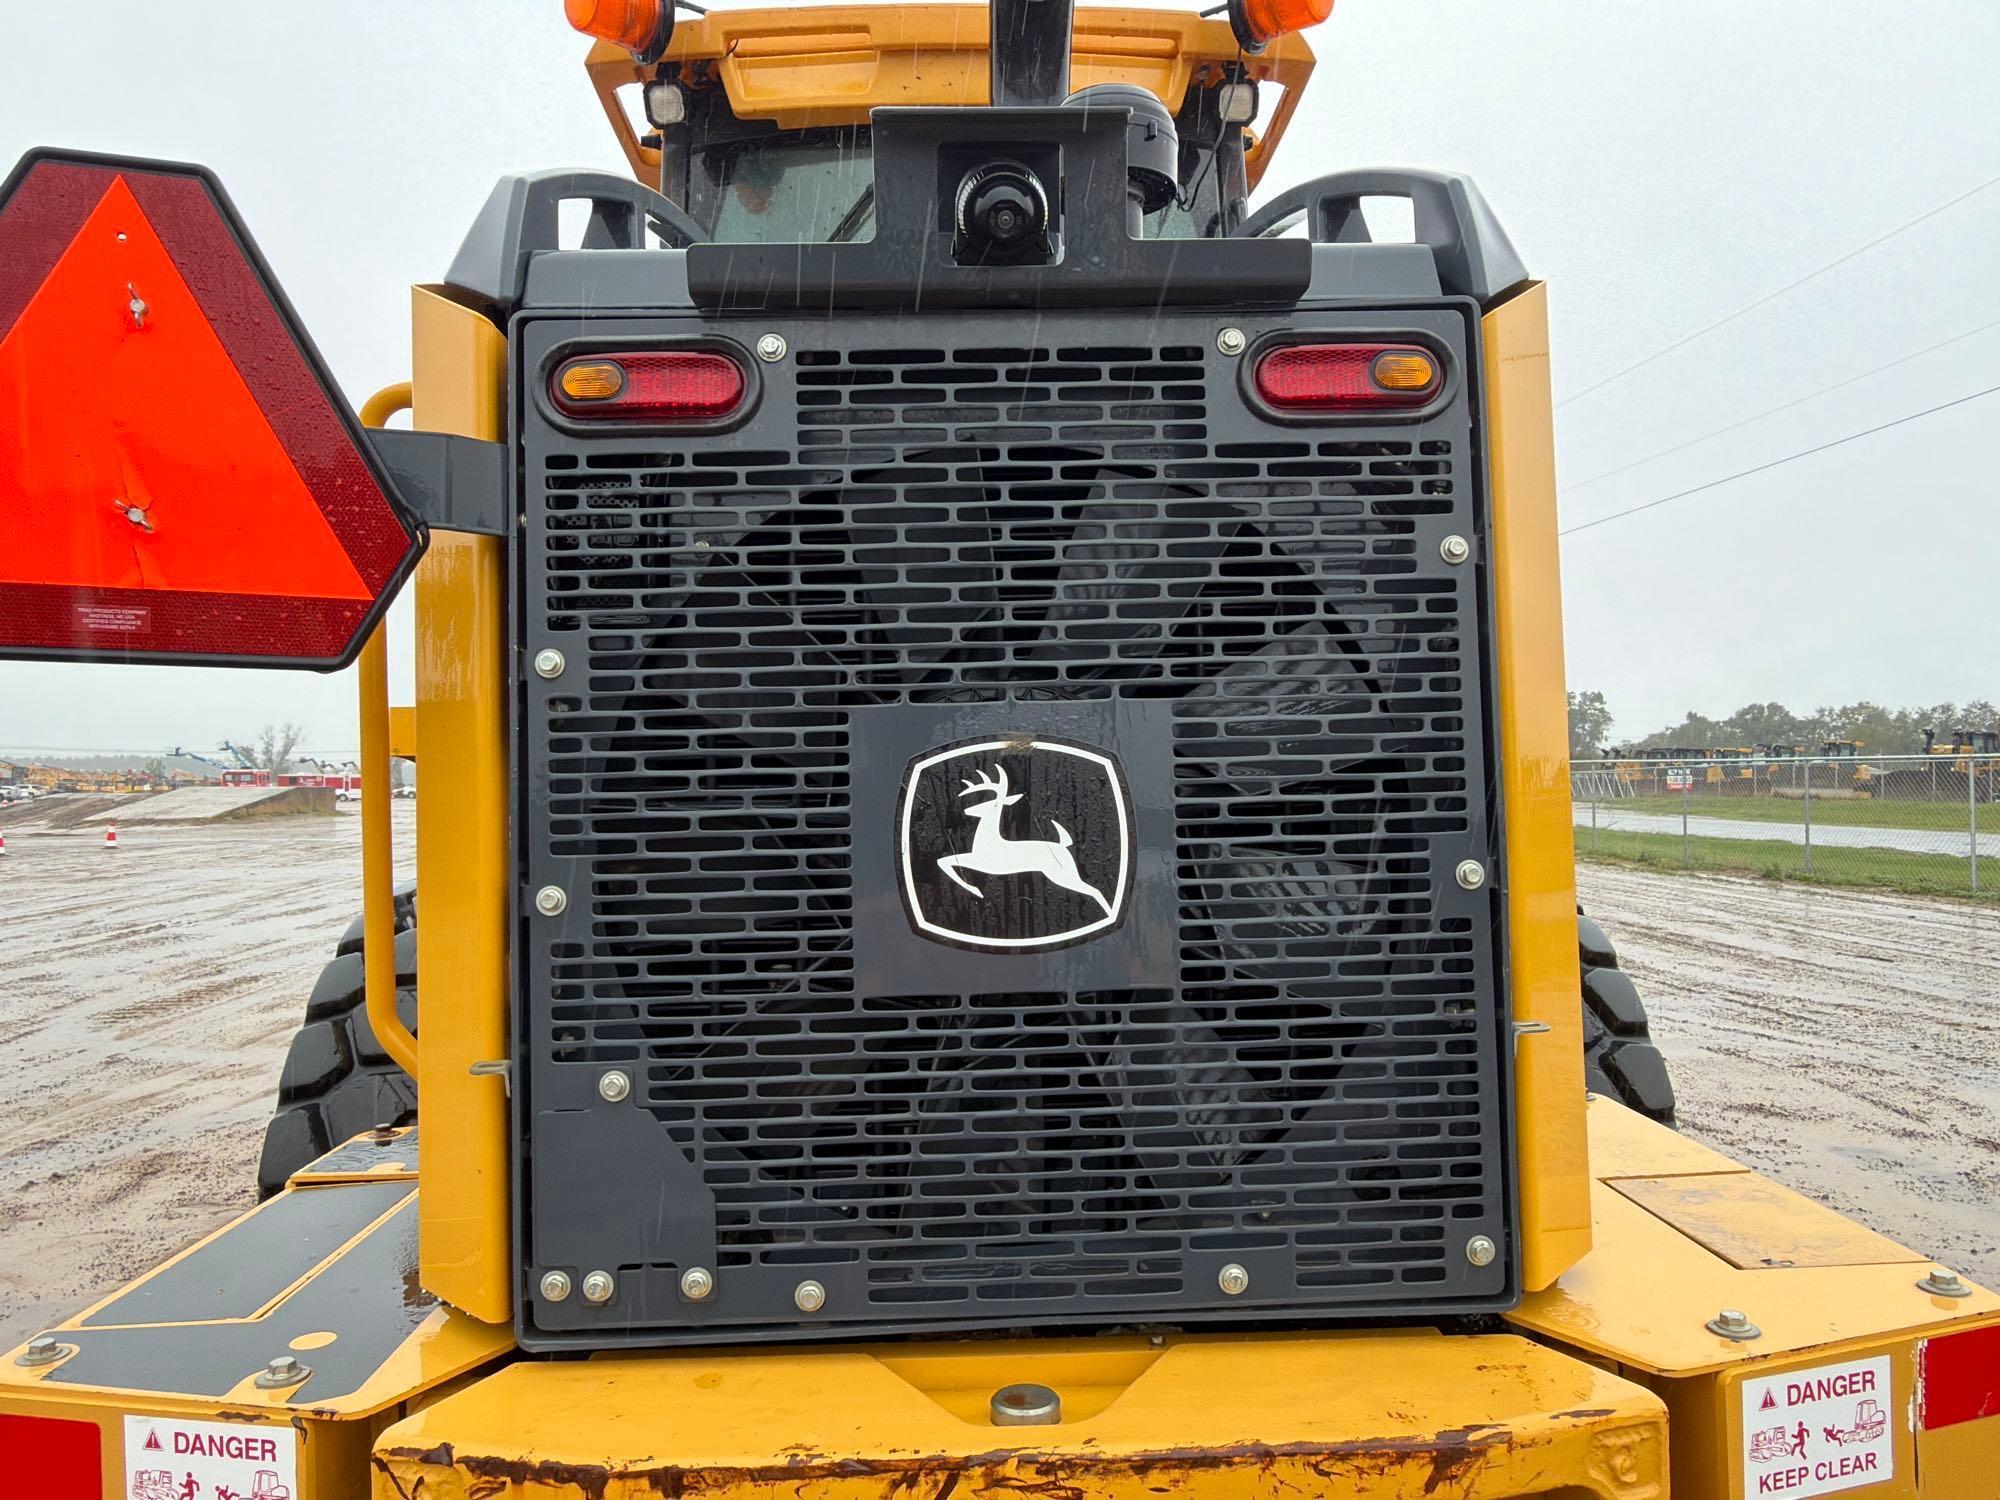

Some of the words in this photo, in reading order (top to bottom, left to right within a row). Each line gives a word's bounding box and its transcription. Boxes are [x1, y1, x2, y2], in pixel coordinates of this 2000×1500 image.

[1787, 1370, 1876, 1406] DANGER
[174, 1431, 277, 1462] DANGER
[1759, 1466, 1809, 1494] KEEP
[1815, 1452, 1877, 1481] CLEAR
